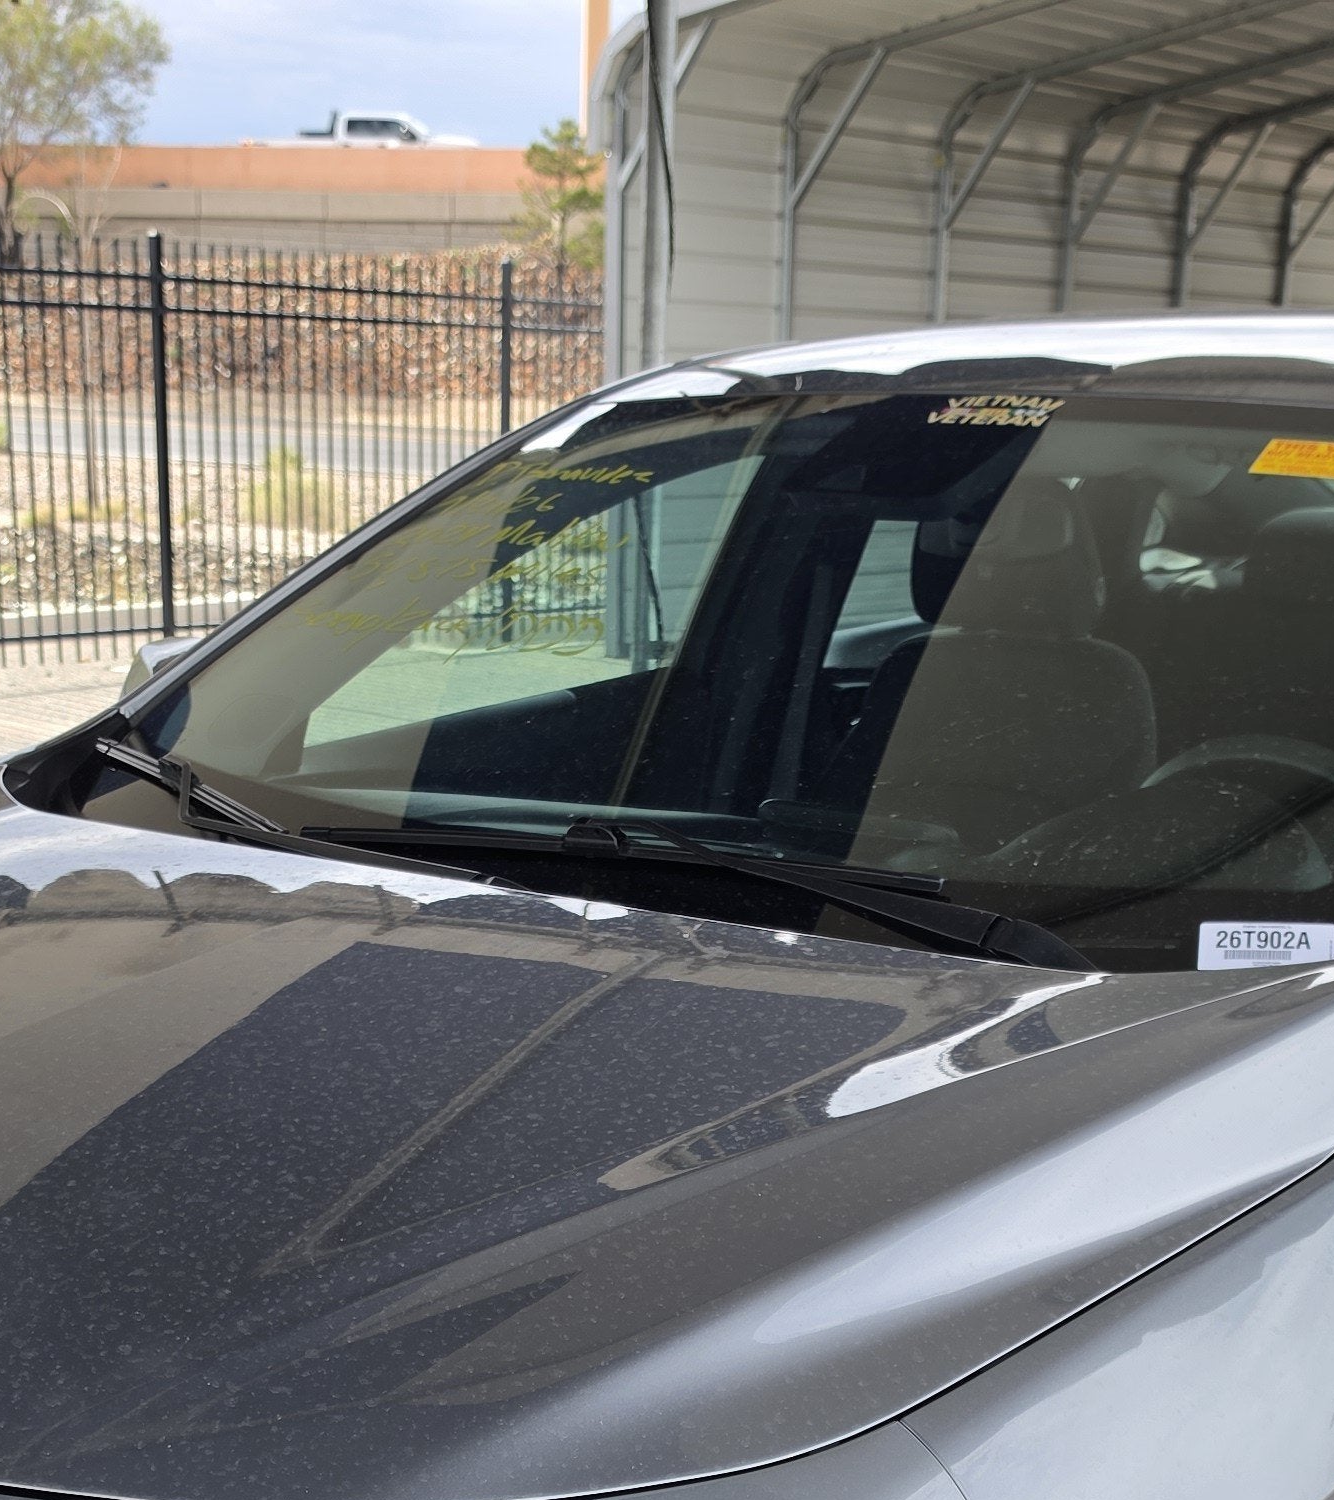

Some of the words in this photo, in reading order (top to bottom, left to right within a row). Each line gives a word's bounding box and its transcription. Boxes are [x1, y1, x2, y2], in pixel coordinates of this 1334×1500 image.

[947, 395, 1067, 413] VIETNAM
[927, 411, 1052, 428] VETERAN
[1216, 930, 1311, 950] 26T902A
